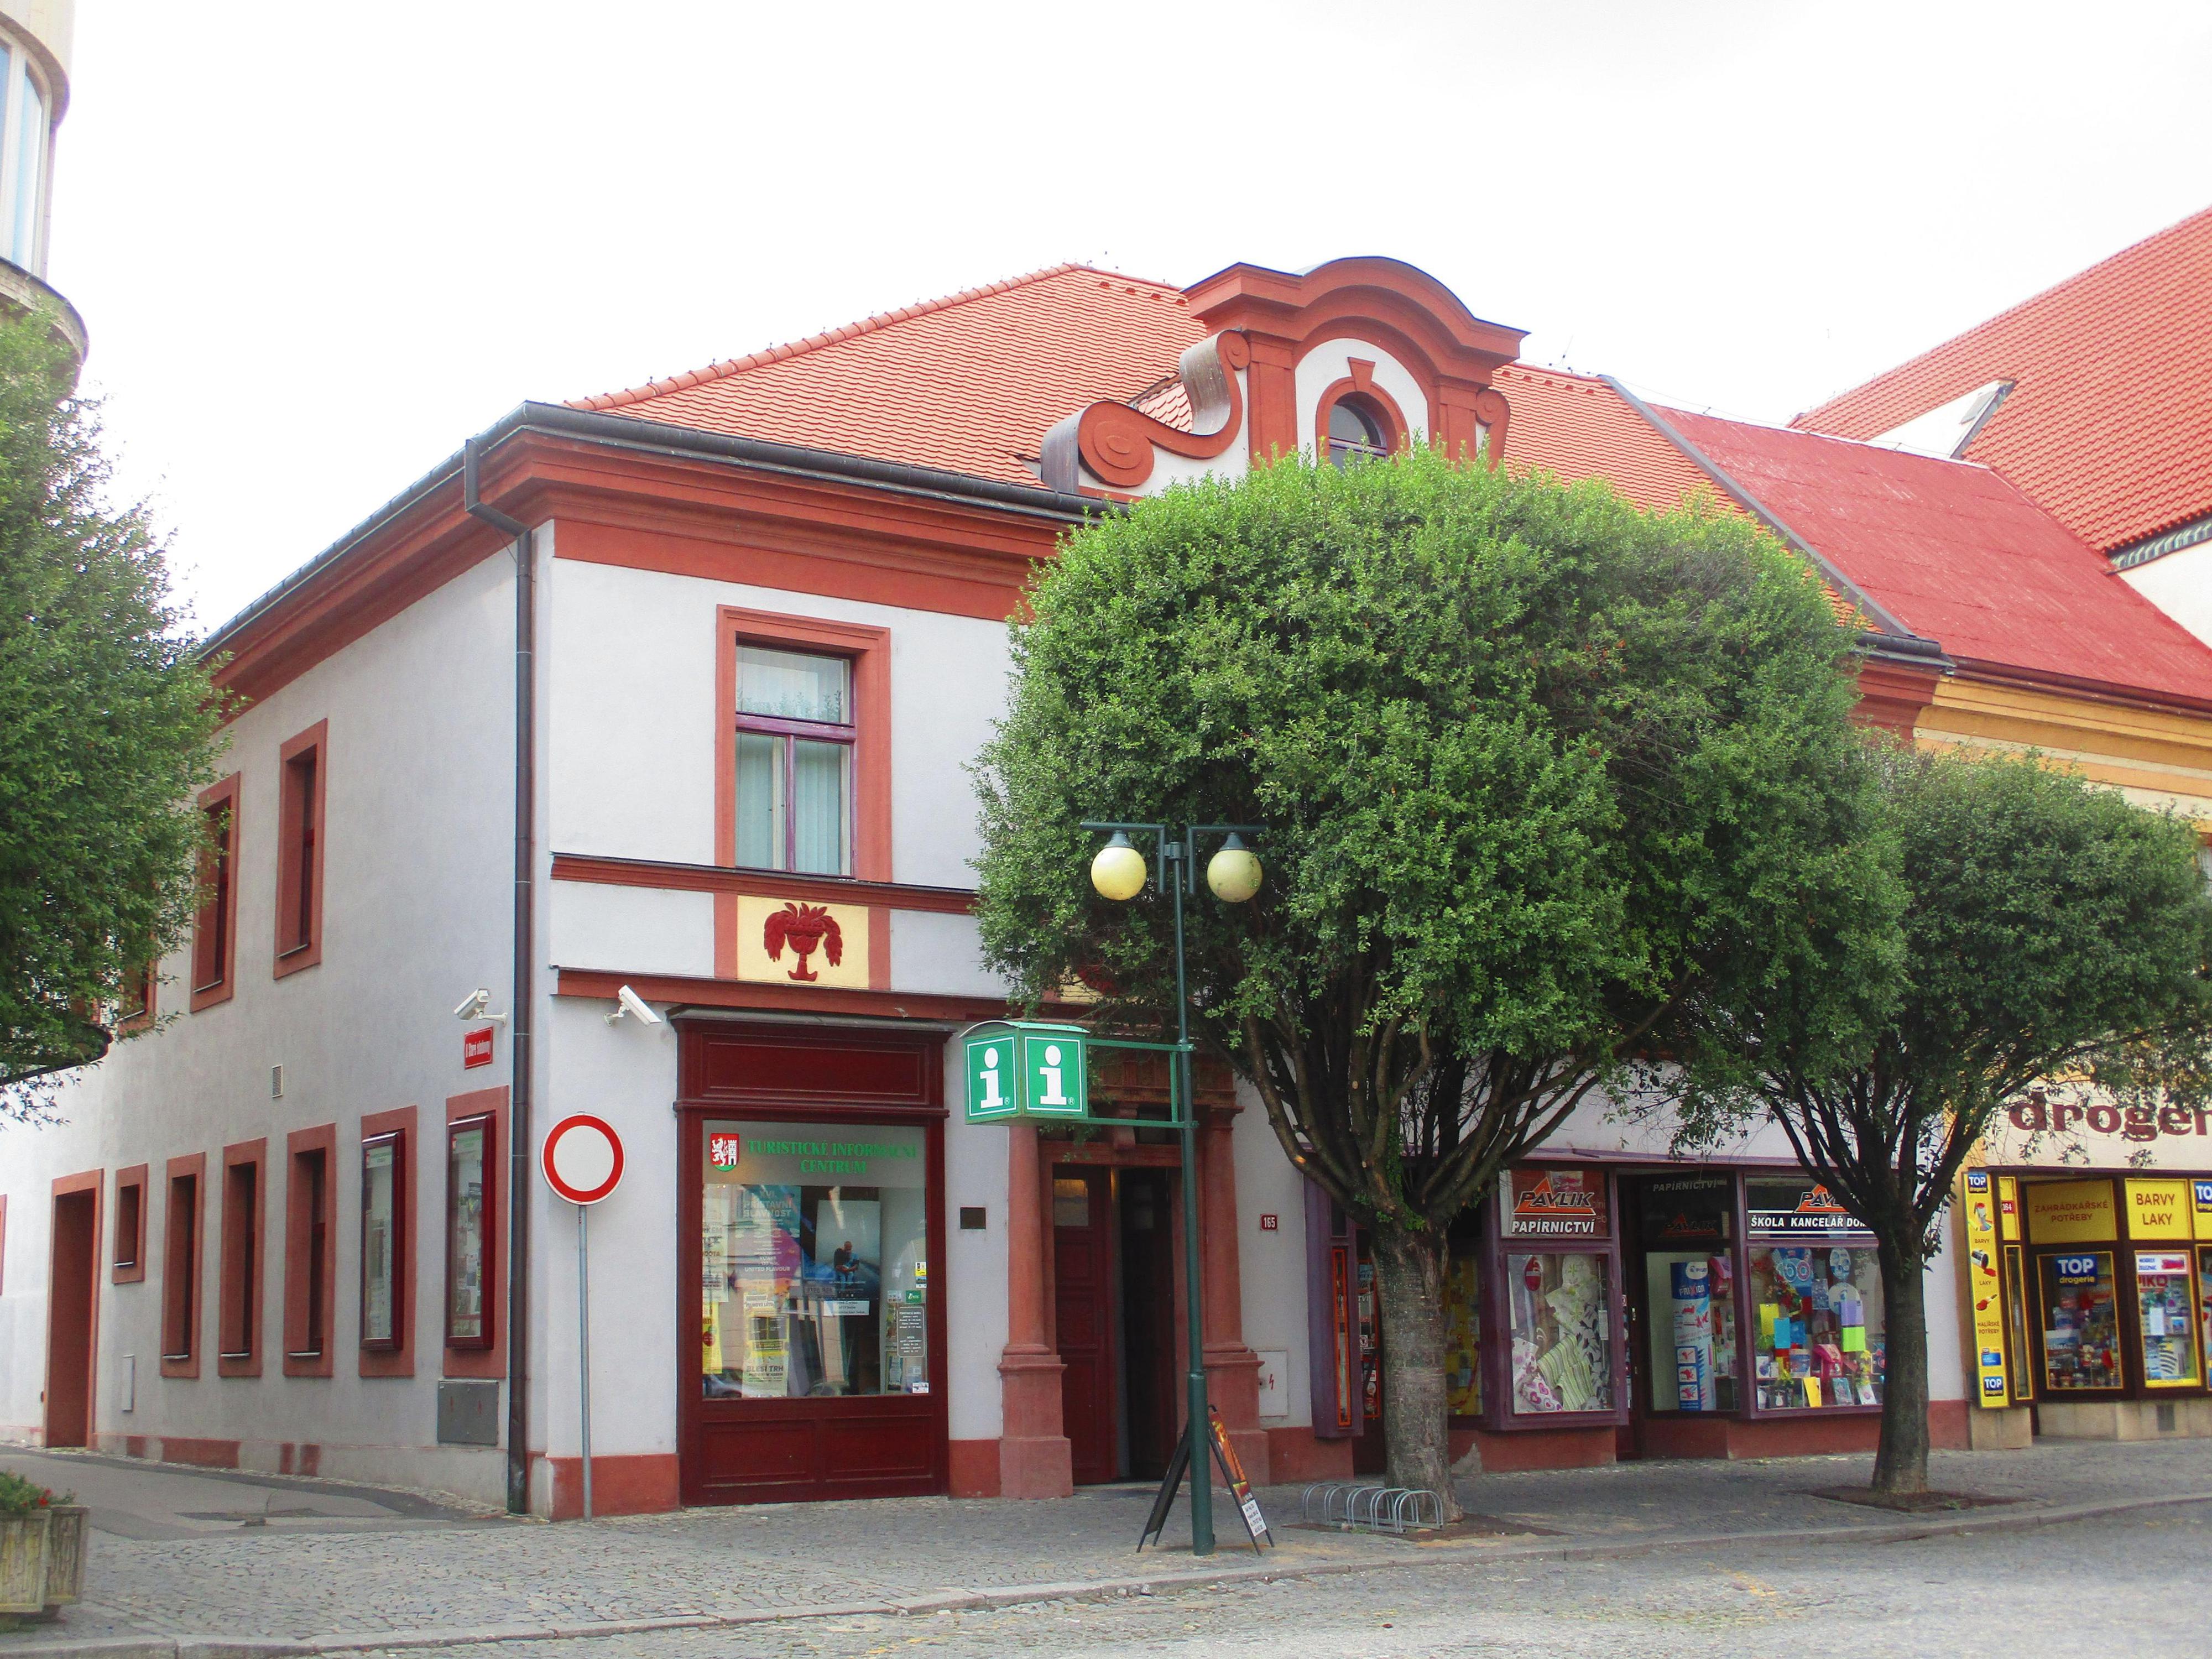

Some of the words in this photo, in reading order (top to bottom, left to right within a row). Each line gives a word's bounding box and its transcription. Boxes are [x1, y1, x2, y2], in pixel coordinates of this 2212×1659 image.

[800, 1160, 867, 1173] CENTRUM
[1969, 1176, 1986, 1186] TOP
[1517, 1190, 1595, 1208] PAVLIK
[2136, 1193, 2176, 1206] BARVY
[2002, 1203, 2012, 1211] 164
[1264, 1217, 1275, 1228] 165
[1751, 1215, 1785, 1228] ŠKOLA
[1791, 1215, 1843, 1228] KANCELÁŘ
[2142, 1213, 2173, 1225] LAKY
[1511, 1218, 1595, 1233] PAPÍRNICTVÍ
[2057, 1258, 2094, 1275] TOP
[2059, 1275, 2096, 1285] drogerie
[1984, 1378, 2002, 1389] TOP
